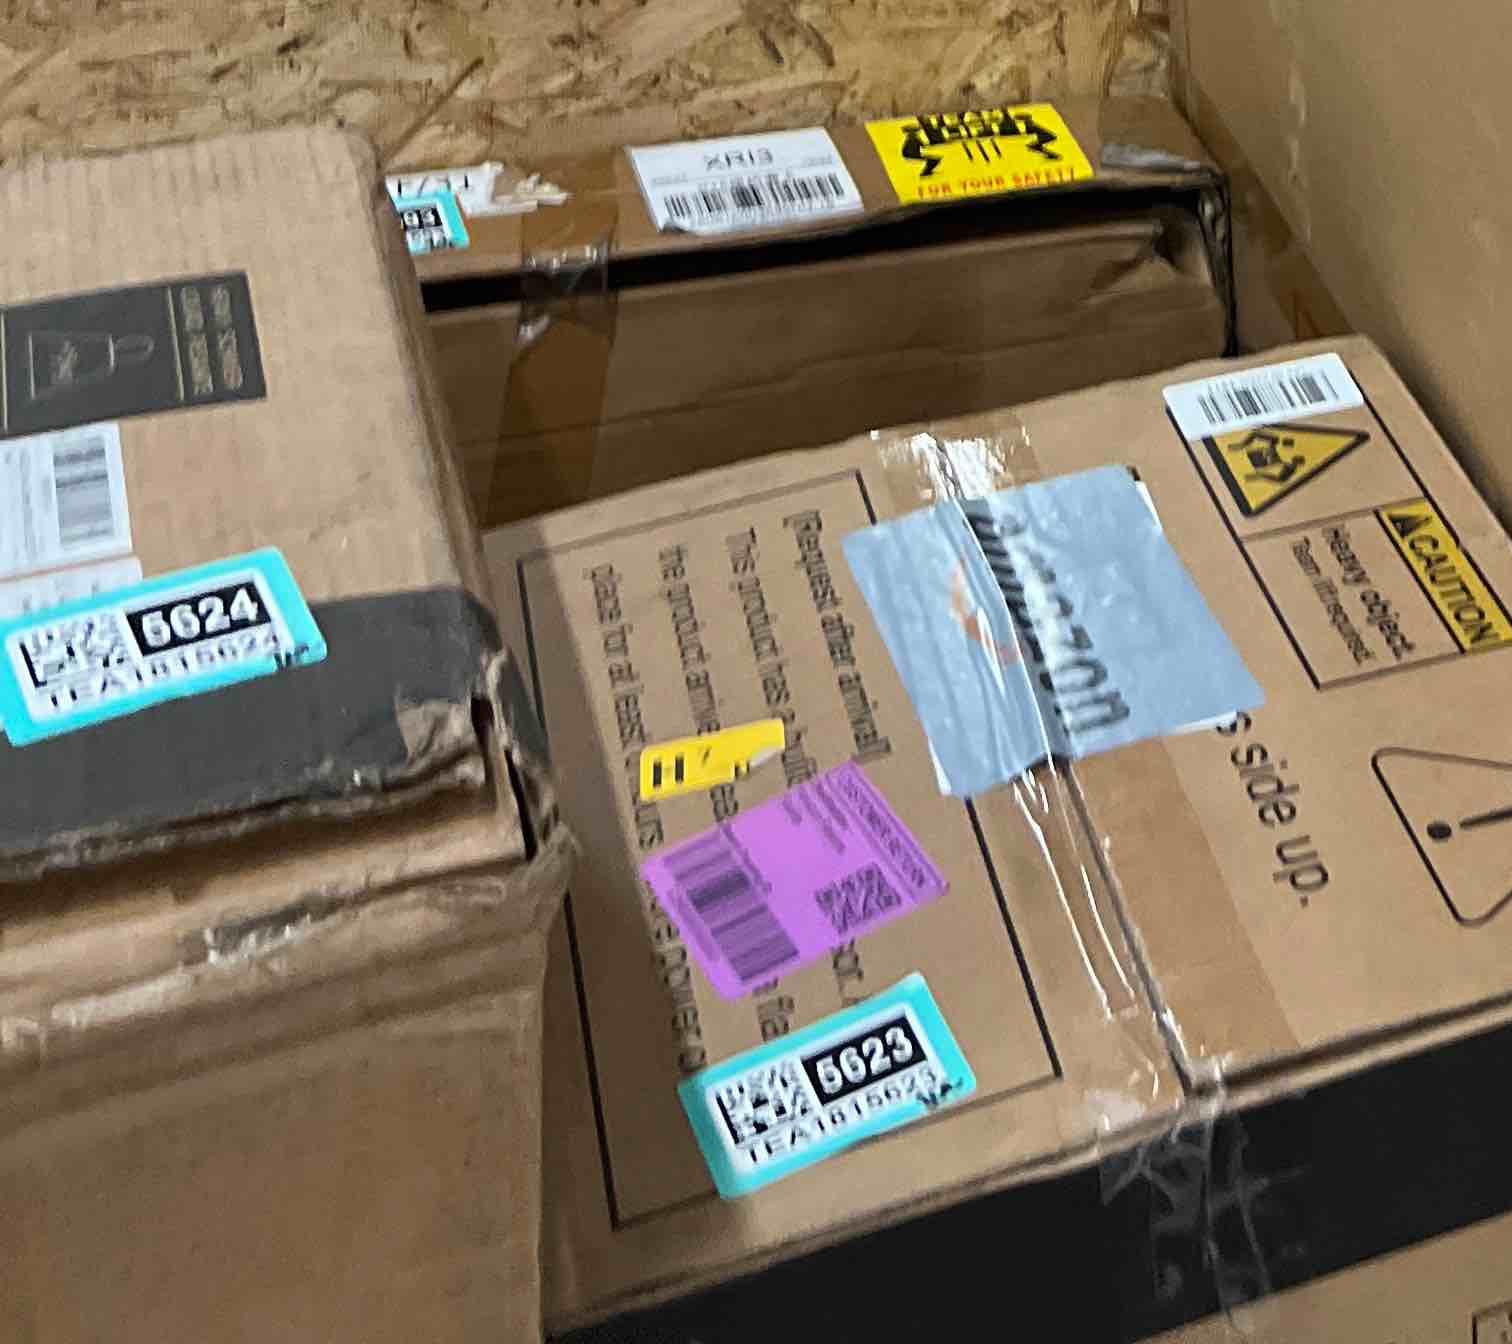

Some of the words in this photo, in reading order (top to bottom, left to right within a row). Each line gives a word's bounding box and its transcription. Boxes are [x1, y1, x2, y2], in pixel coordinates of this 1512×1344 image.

[140, 587, 259, 648] 5624
[1406, 533, 1502, 649] CAUTION
[1230, 742, 1300, 829] side
[1272, 834, 1329, 909] up.
[814, 1025, 914, 1096] 5623
